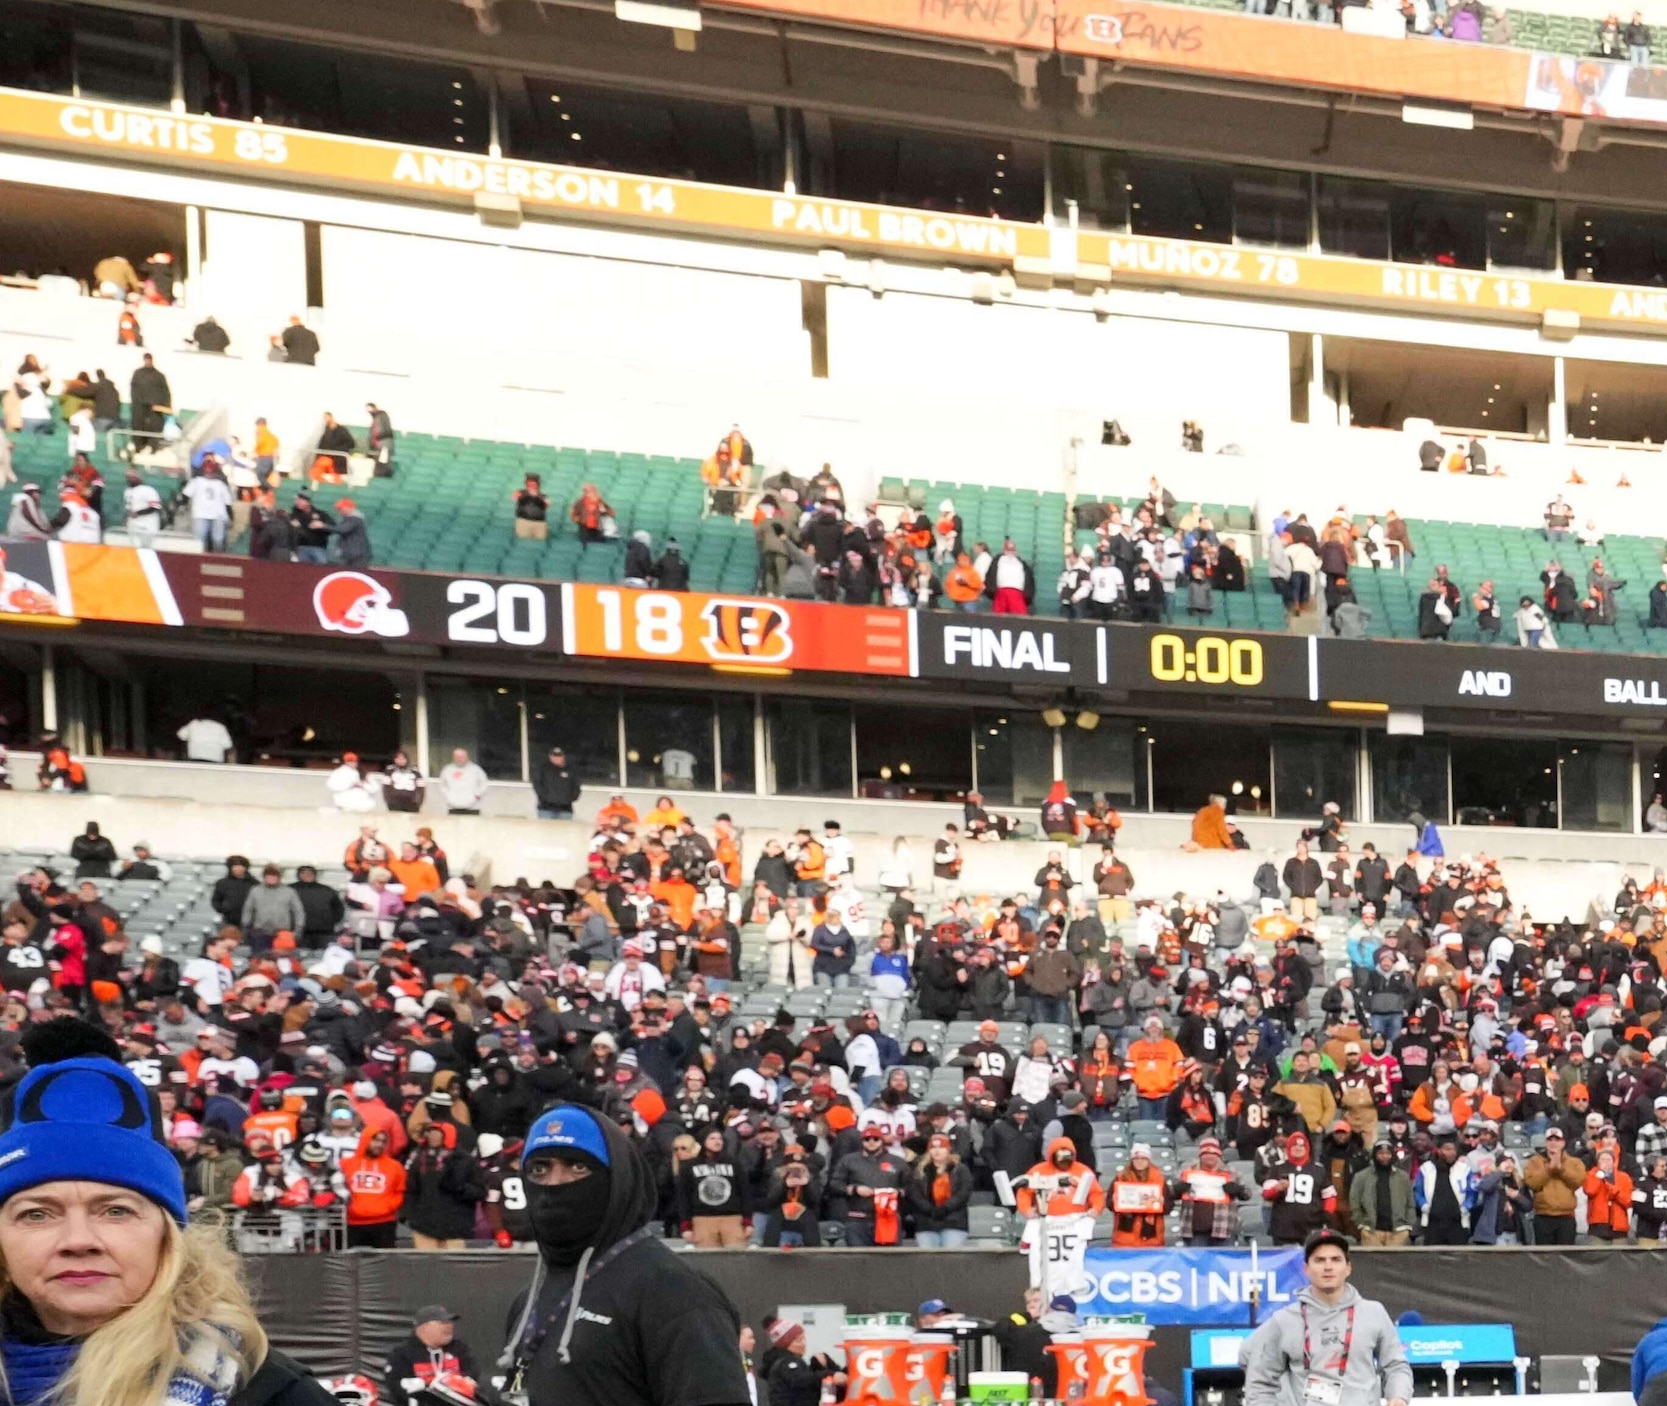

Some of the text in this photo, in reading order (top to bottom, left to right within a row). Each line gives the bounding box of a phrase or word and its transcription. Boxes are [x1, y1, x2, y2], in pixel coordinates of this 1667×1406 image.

[59, 106, 288, 165] CURTIS 85
[393, 152, 675, 215] ANDERSON 14
[772, 199, 1017, 256] PAUL BROWN
[1108, 239, 1299, 285] MUÑOZ 78
[1382, 267, 1531, 308] RILEY 13
[446, 579, 547, 645] 20
[595, 590, 684, 655] 18
[943, 625, 1264, 686] FINAL 0:00
[1457, 670, 1512, 699] AND
[1603, 678, 1667, 706] BALL
[501, 1176, 527, 1210] 9
[1285, 1172, 1315, 1204] 19
[1099, 1269, 1291, 1304] CBS NFL
[856, 1349, 885, 1379] G
[1103, 1348, 1131, 1375] G
[1409, 1339, 1463, 1352] Copilot
